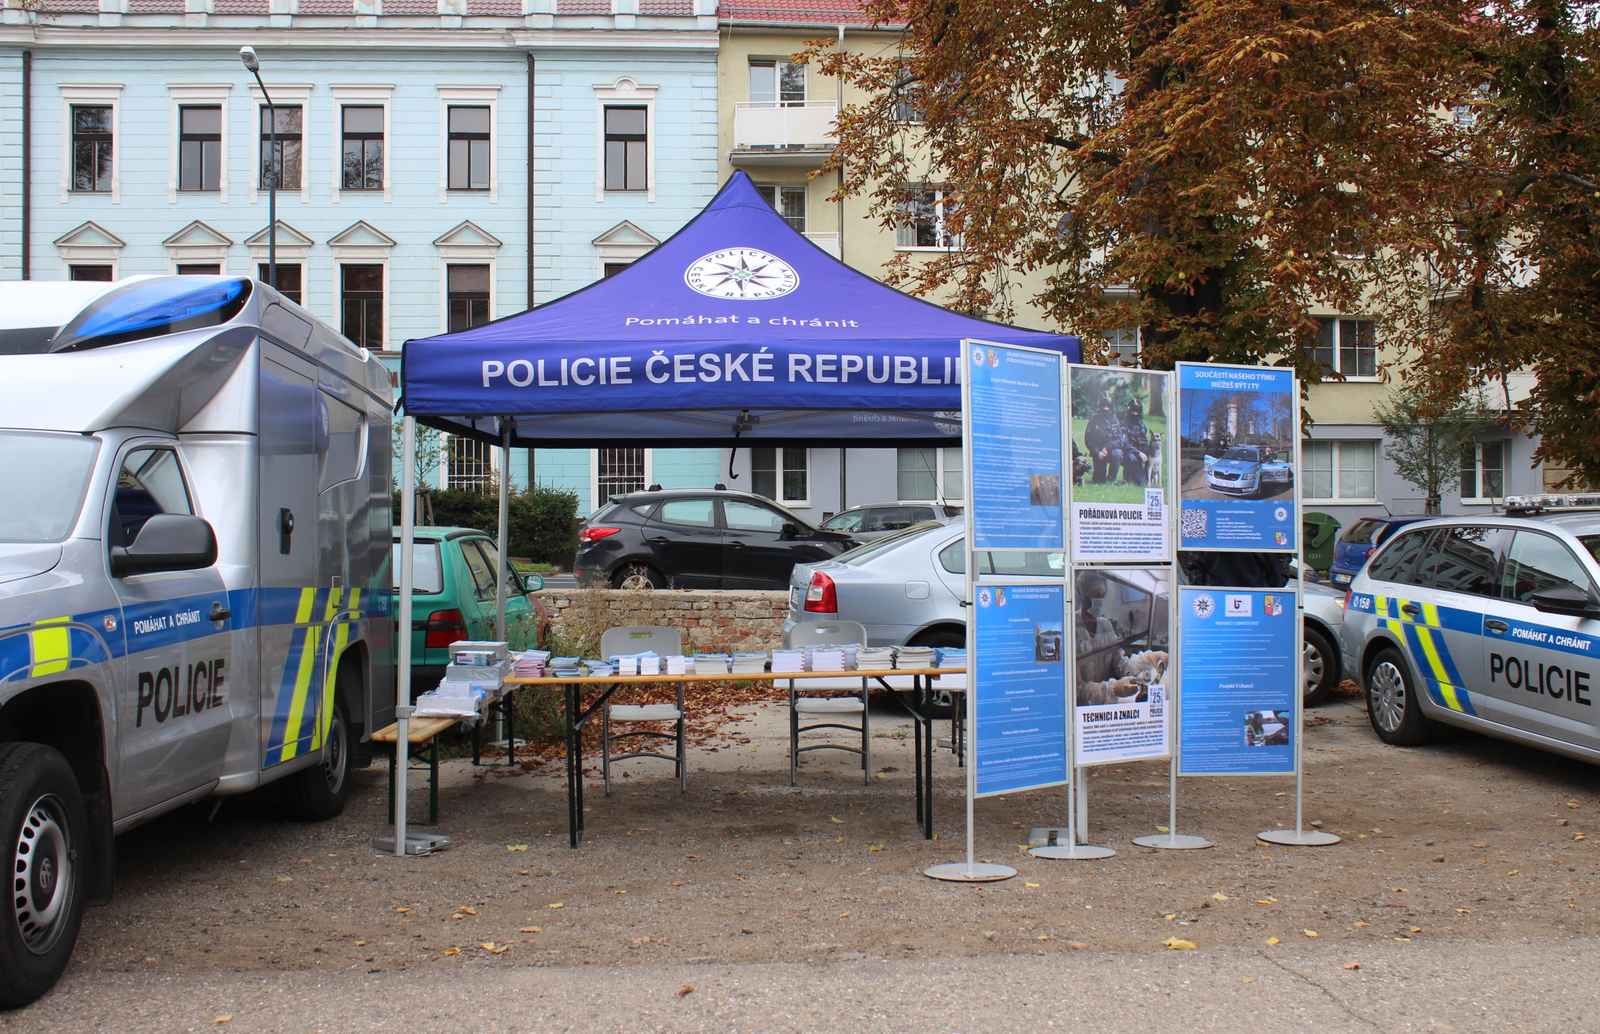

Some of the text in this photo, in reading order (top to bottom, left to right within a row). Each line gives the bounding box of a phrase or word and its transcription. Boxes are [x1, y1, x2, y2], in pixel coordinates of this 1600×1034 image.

[705, 250, 776, 263] POLICIE
[625, 314, 860, 328] Pomáhat a chránit
[482, 356, 633, 387] POLICIE
[645, 347, 775, 384] ČESKÉ
[1118, 510, 1143, 520] POLICIE
[134, 609, 200, 635] POMÁHAT A CHRÁNIT
[1512, 627, 1592, 650] POMÁHAT A CHRÁNIT
[1490, 652, 1592, 706] POLICIE
[136, 658, 225, 728] POLICIE
[1082, 711, 1113, 723] TECHNICI
[1113, 711, 1118, 720] A
